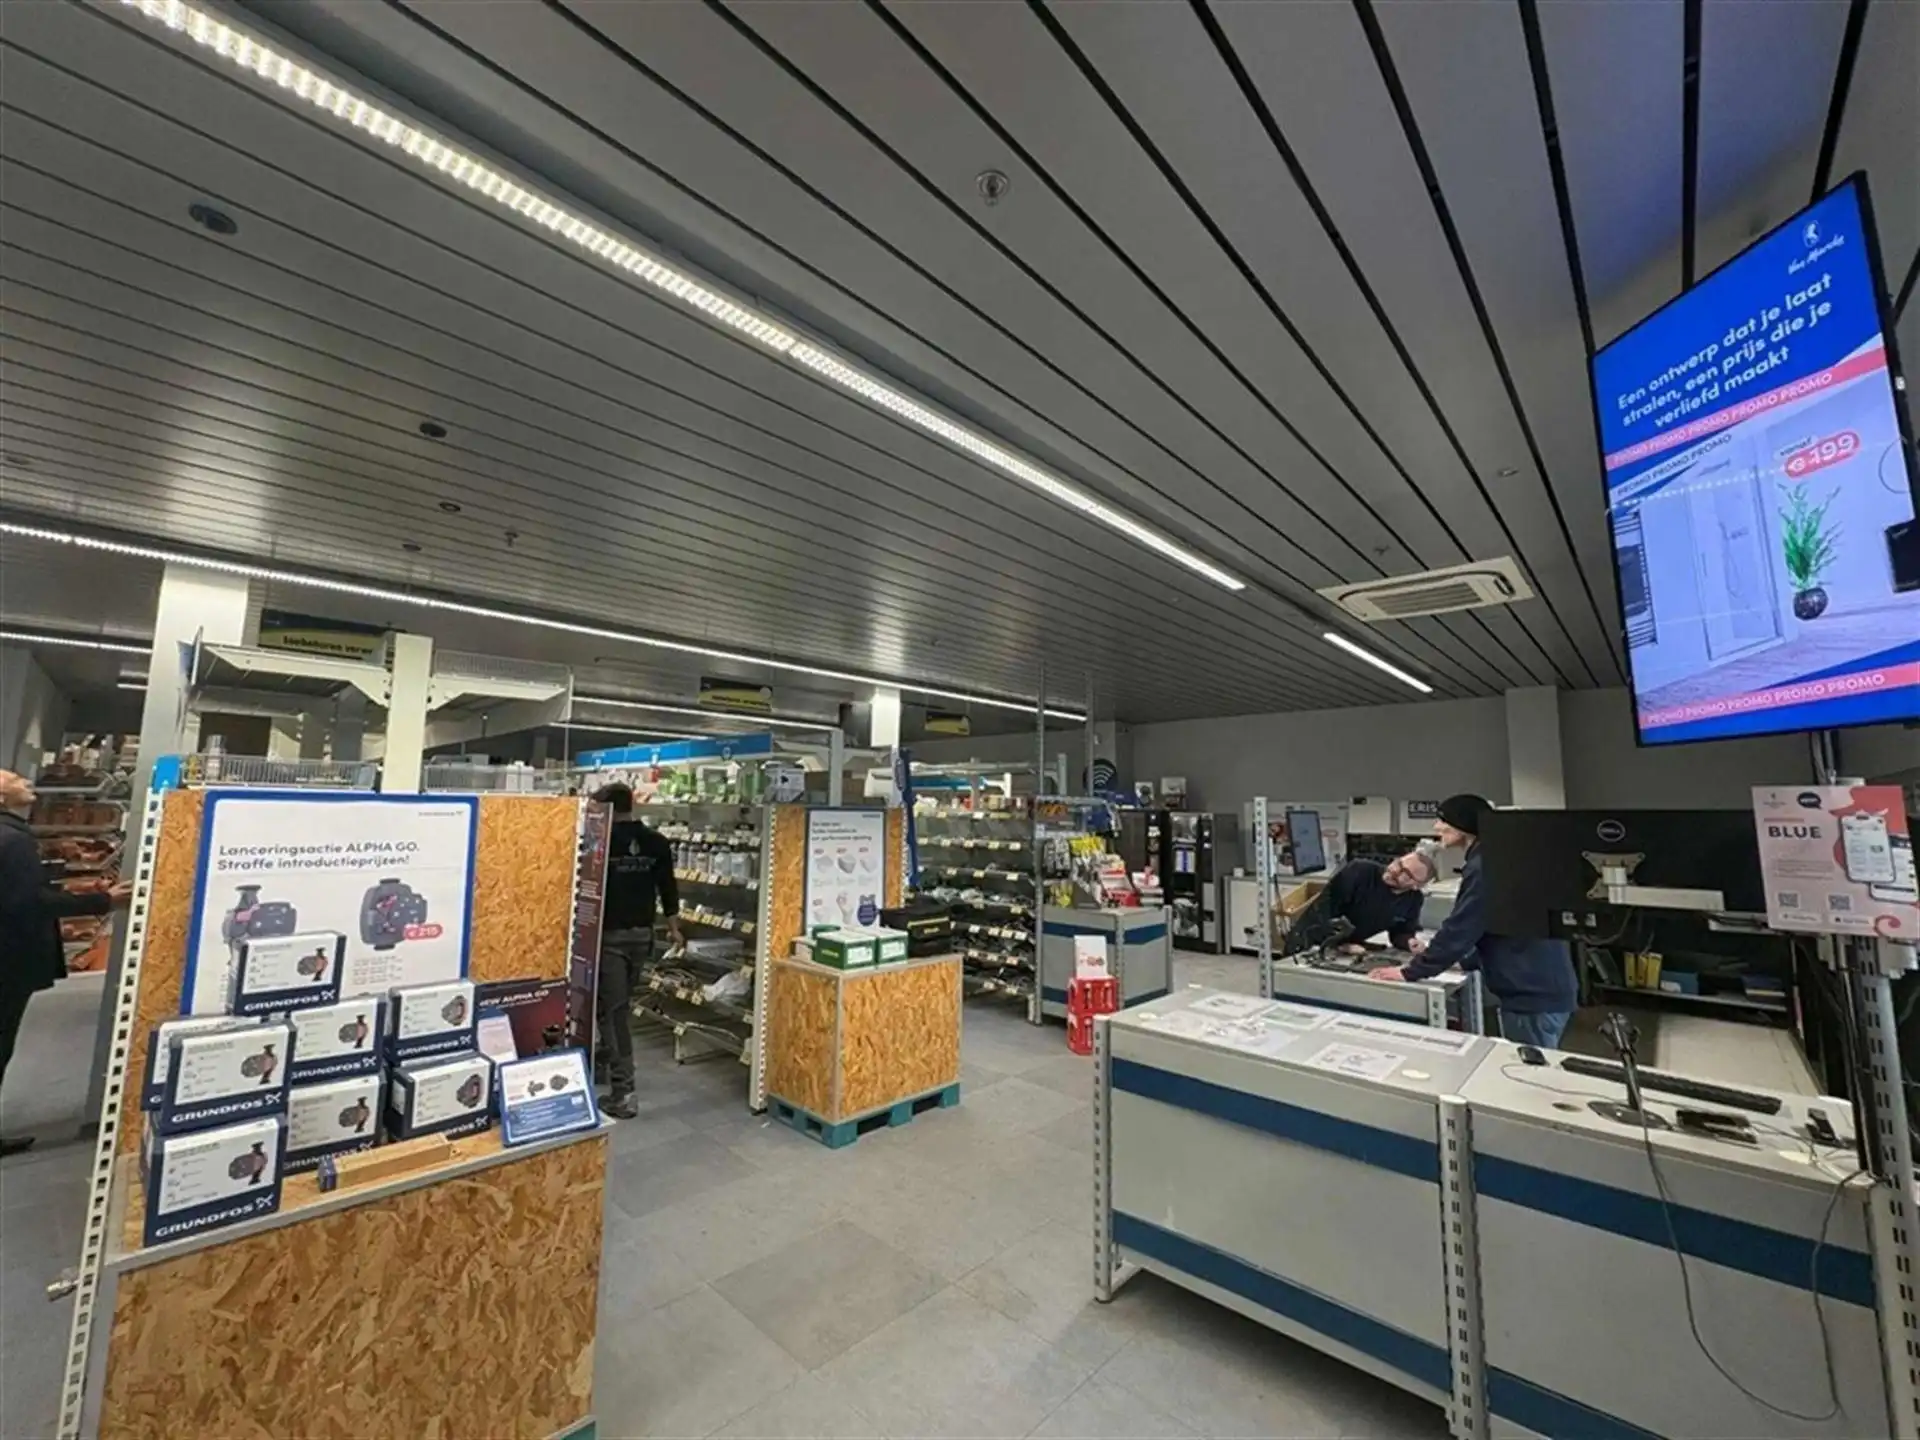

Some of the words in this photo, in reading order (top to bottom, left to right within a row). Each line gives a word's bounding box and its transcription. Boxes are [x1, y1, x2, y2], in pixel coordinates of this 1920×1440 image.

[1617, 387, 1646, 410] Een
[1649, 343, 1719, 392] ontwerp
[1723, 318, 1757, 348] dat
[1759, 306, 1781, 332] je
[1785, 273, 1832, 311] laat
[1623, 389, 1682, 428] stralen,
[1685, 366, 1719, 392] een
[1722, 338, 1766, 375] prijs
[1770, 316, 1806, 343] die
[1808, 300, 1832, 328] je
[1654, 382, 1720, 428] verliefd
[1724, 345, 1790, 393] maakt
[1731, 393, 1779, 421] PROMO
[1780, 372, 1833, 401] PROMO
[1691, 433, 1733, 460] PROMO
[1728, 694, 1773, 709] PROMO
[1775, 684, 1825, 704] PROMO
[1828, 673, 1885, 693] PROMO
[1767, 825, 1822, 839] BLUE
[217, 857, 274, 871] Straffe
[277, 853, 410, 869] introductieprijzen!
[218, 843, 343, 858] Lanceringsactie
[345, 841, 393, 854] ALPHA
[395, 841, 420, 853] GO.
[244, 995, 319, 1012] GRUNDFOS
[171, 1098, 263, 1124] GRUNDFOS
[154, 1202, 254, 1238] GRUNDFOS
